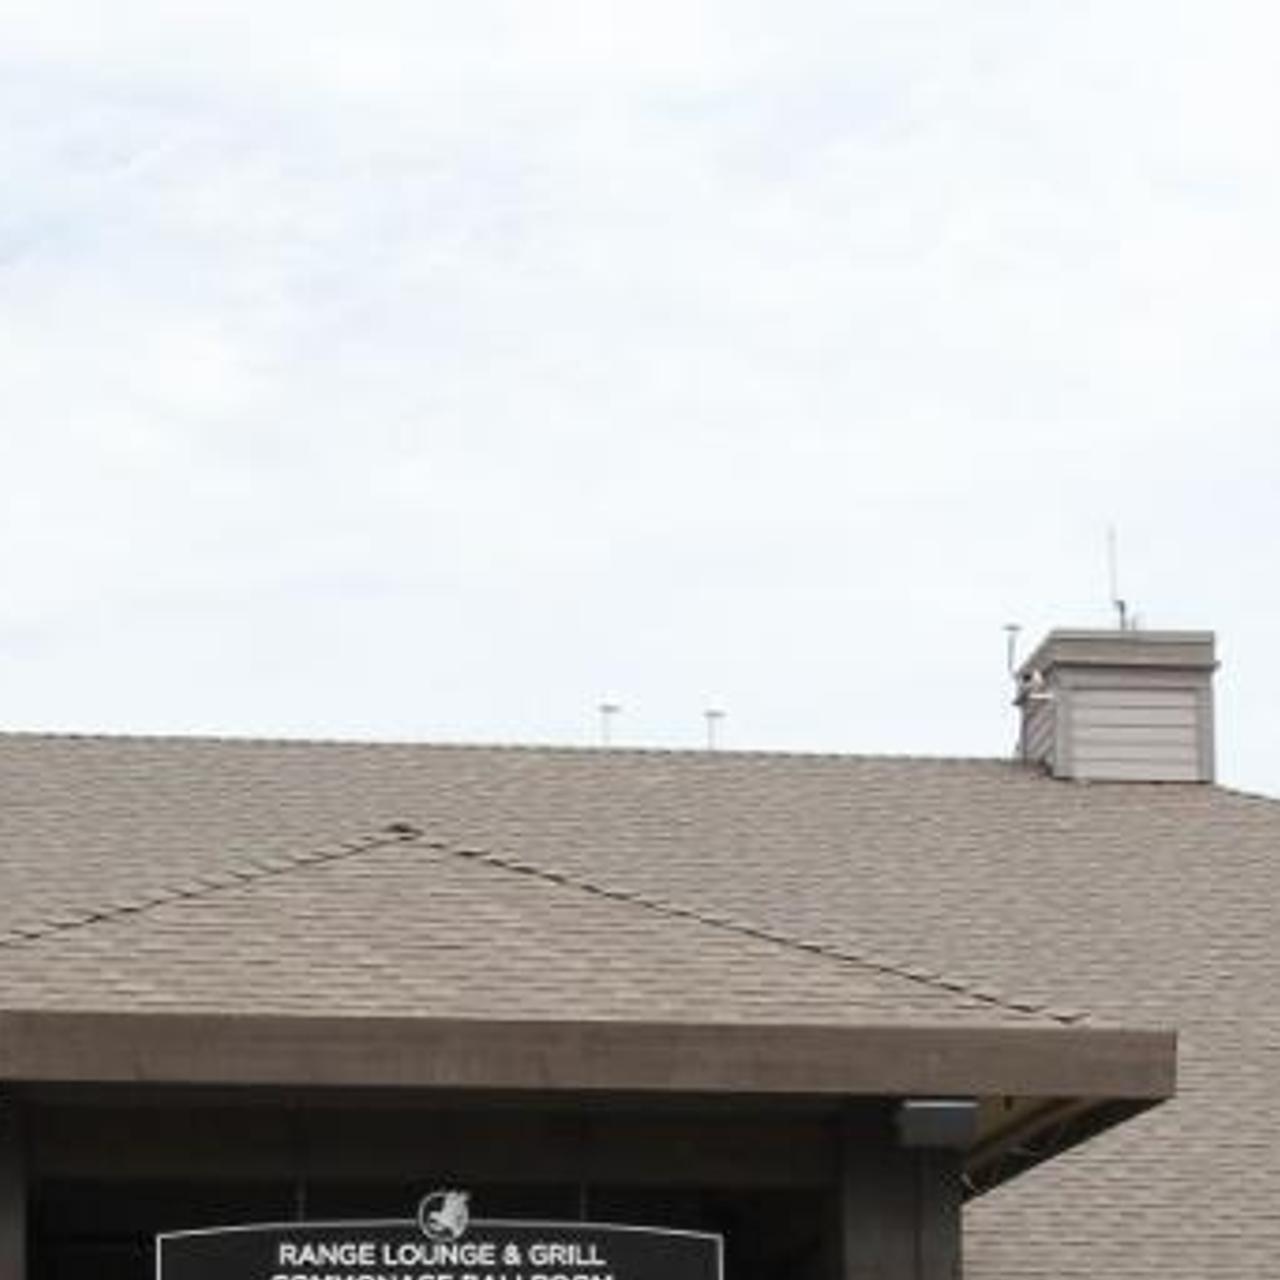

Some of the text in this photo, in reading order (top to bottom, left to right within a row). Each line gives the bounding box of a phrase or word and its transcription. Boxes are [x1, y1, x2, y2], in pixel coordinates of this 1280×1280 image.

[278, 1244, 606, 1267] RANGE LOUNGE & GRILL
